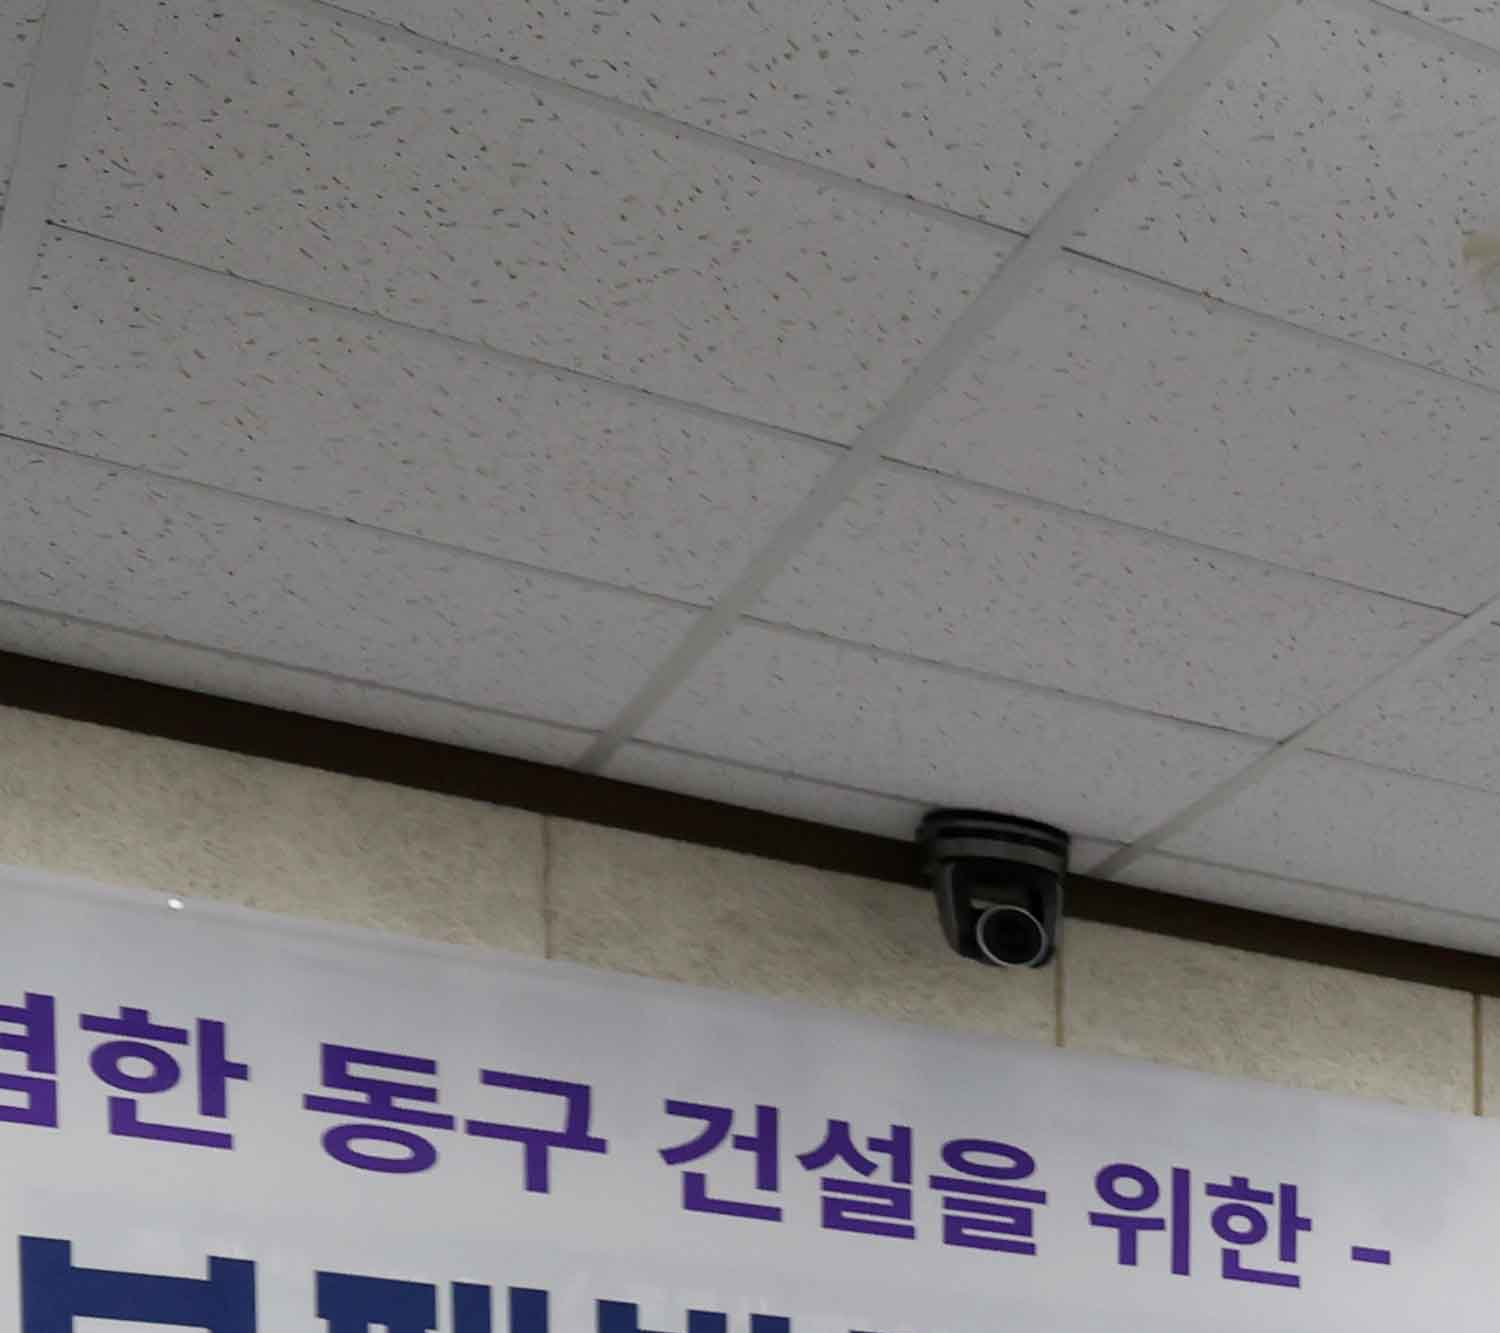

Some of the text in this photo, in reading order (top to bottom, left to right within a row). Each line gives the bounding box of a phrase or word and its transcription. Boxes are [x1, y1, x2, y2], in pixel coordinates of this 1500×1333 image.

[302, 1041, 608, 1195] 동구
[657, 1098, 1047, 1257] 건설을
[1087, 1162, 1312, 1290] 위한
